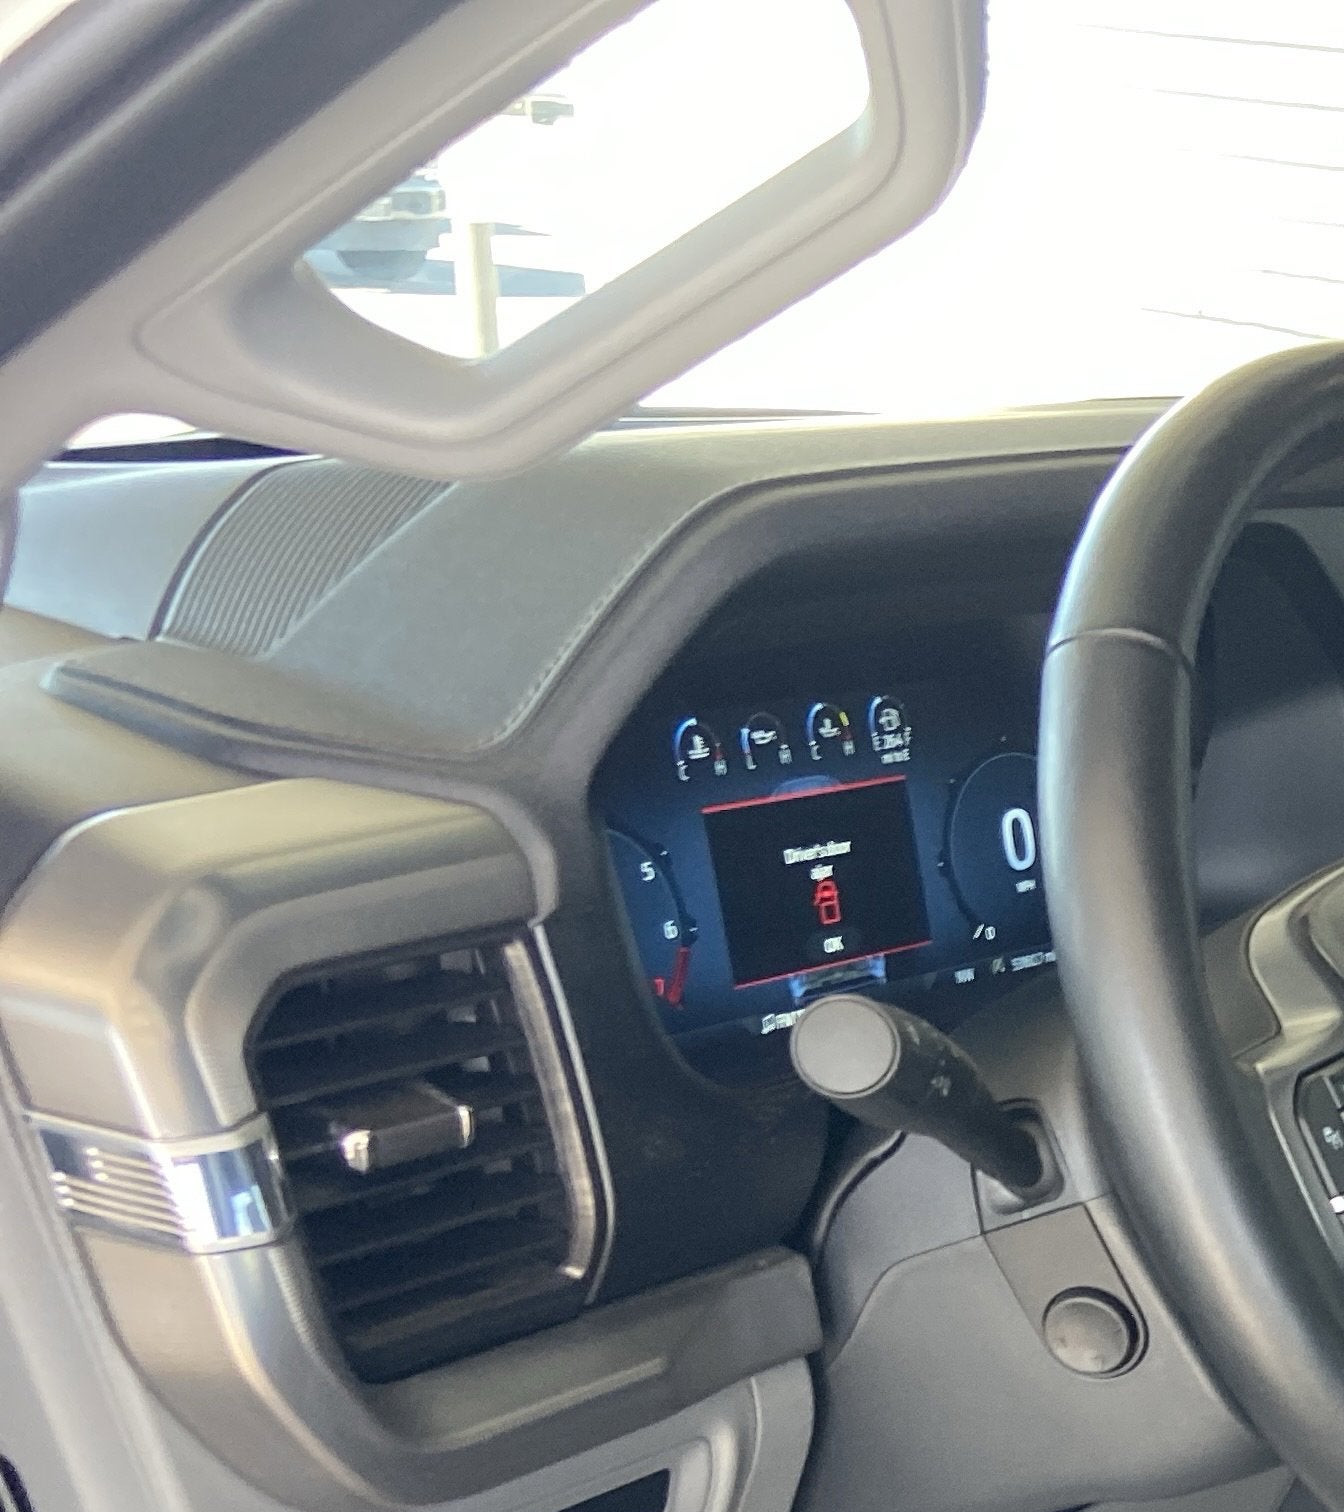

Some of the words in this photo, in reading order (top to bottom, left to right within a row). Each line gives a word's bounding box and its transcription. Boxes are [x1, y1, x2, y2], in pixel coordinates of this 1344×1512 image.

[1001, 808, 1037, 871] 0
[640, 861, 656, 881] 5
[662, 920, 679, 940] 6
